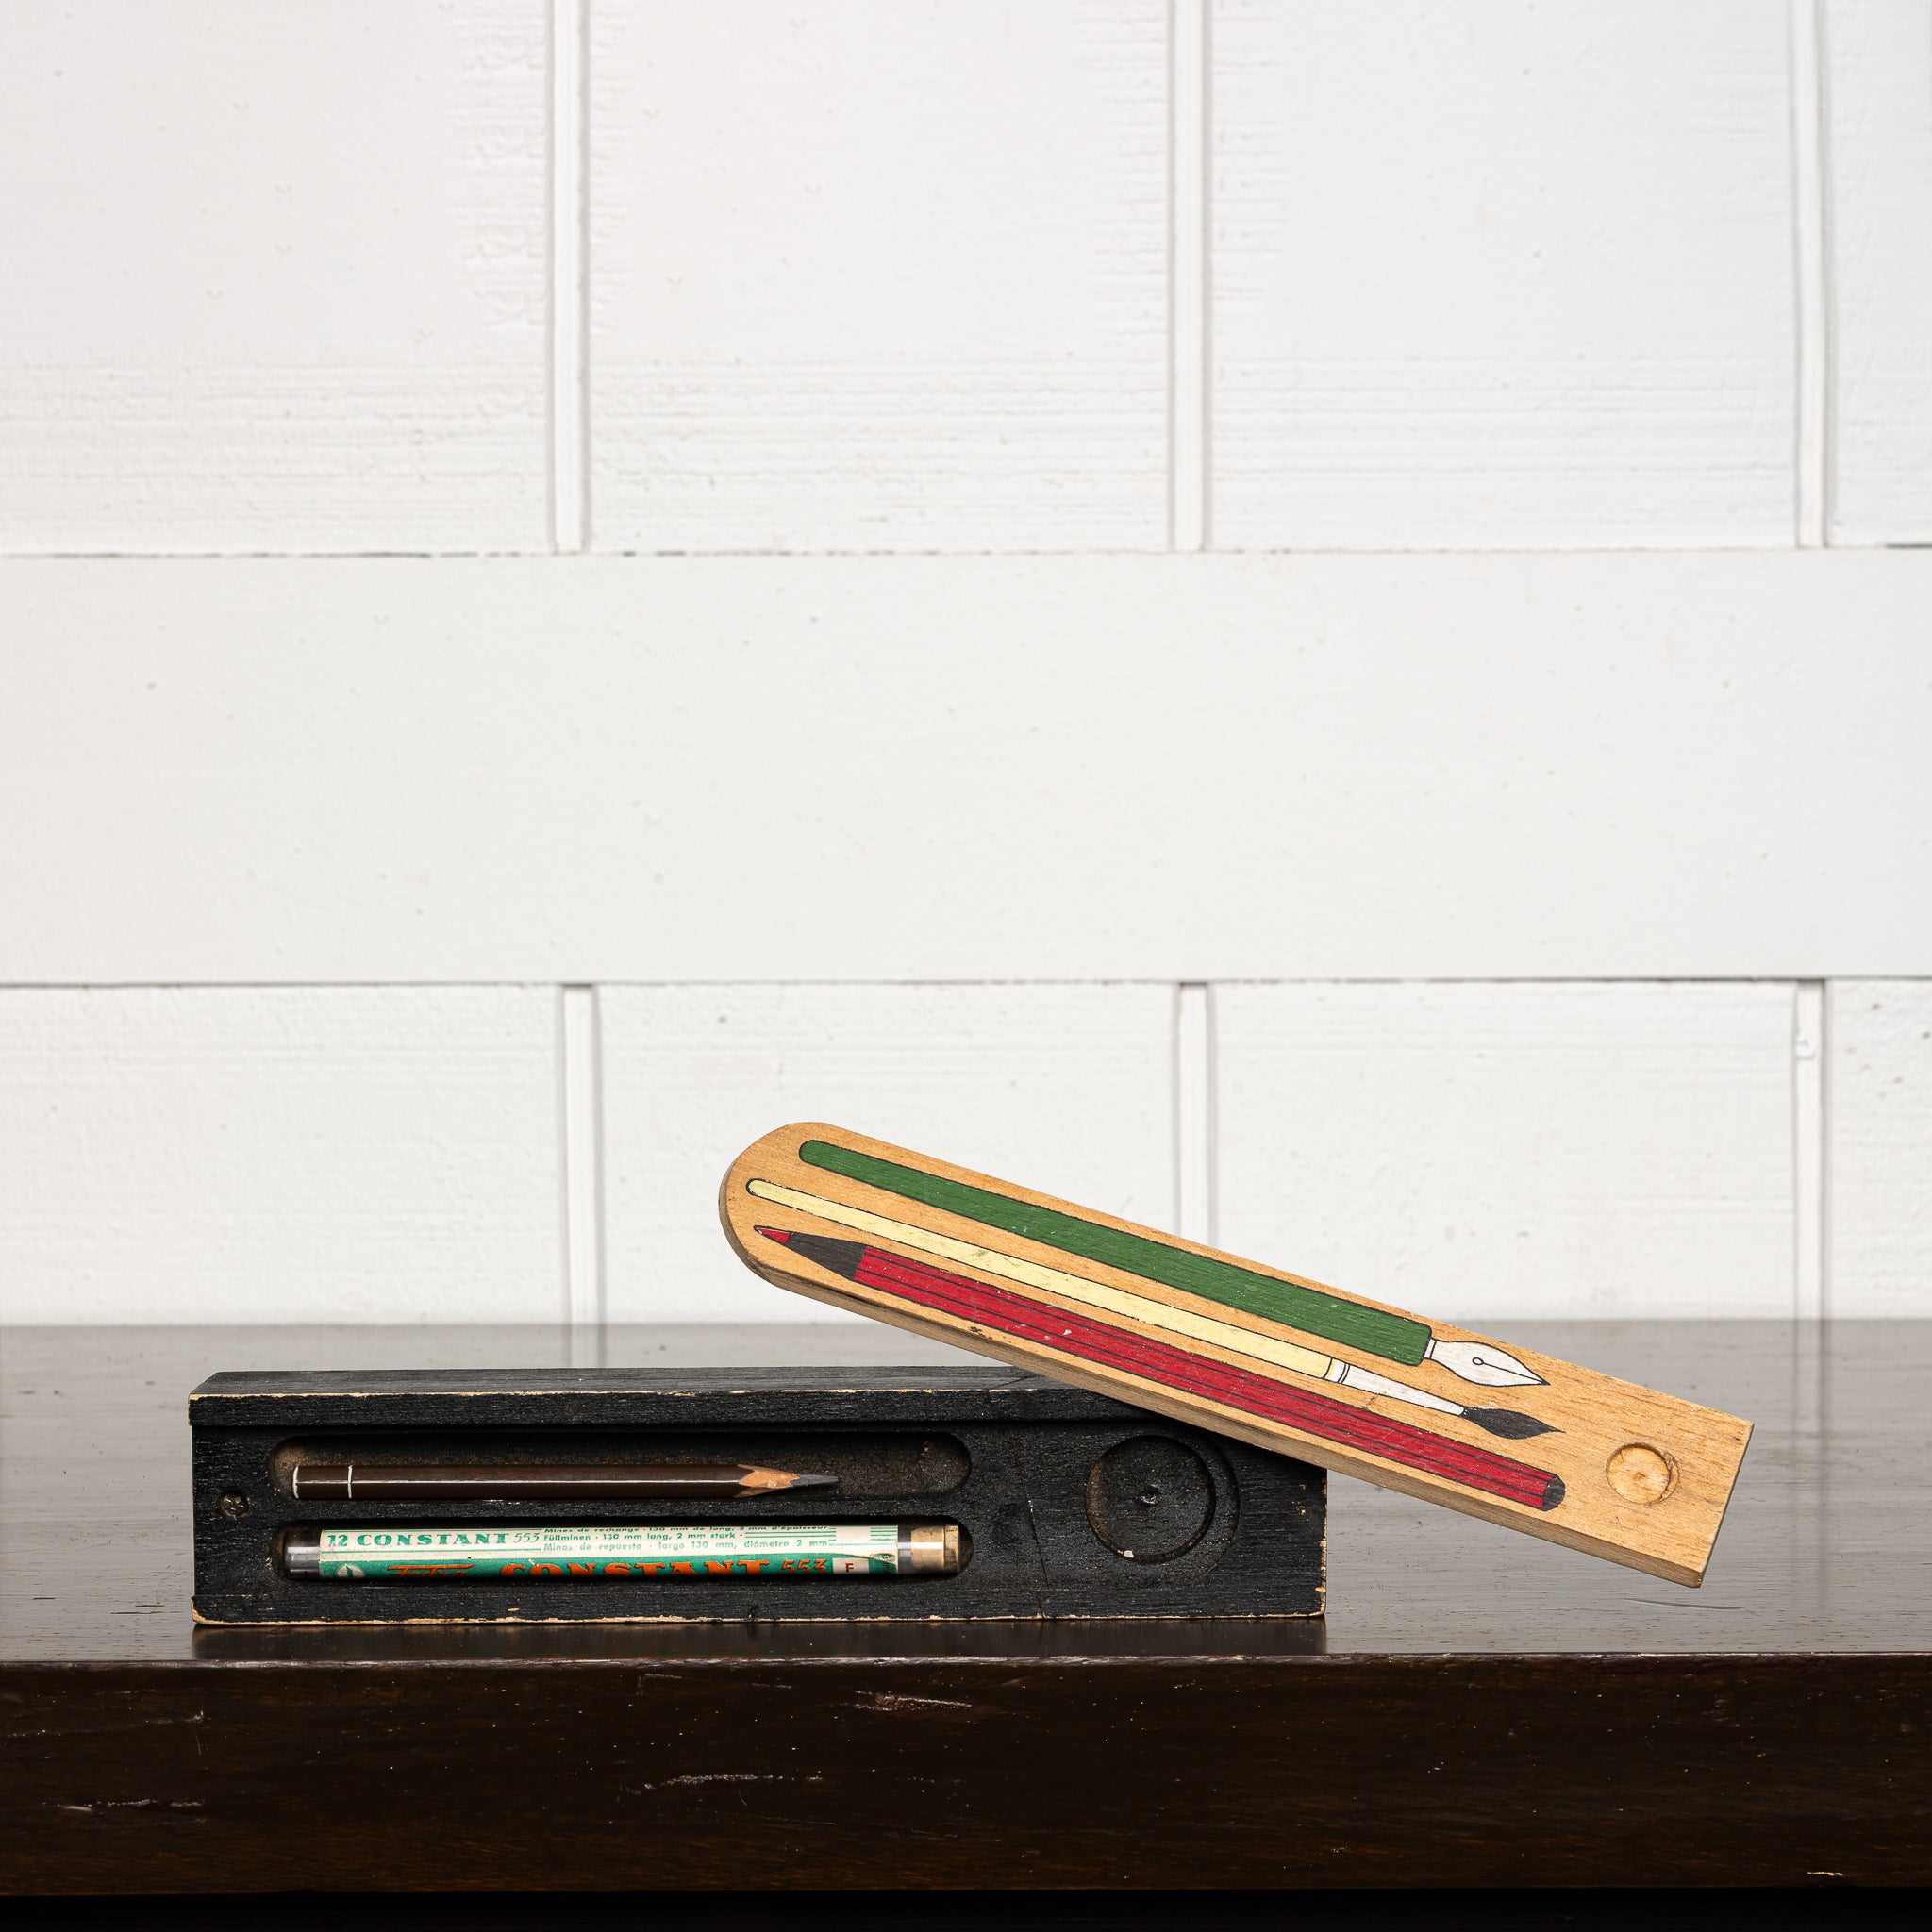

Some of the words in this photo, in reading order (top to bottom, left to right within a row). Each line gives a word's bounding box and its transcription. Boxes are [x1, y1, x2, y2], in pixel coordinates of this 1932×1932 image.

[327, 1534, 348, 1547] 12
[357, 1533, 509, 1546] CONSTANT
[512, 1532, 540, 1543] 553
[599, 1543, 642, 1552] repuesto
[658, 1541, 685, 1551] largo
[796, 1539, 802, 1547] 2
[500, 1559, 769, 1577] CONSTANT
[782, 1559, 827, 1574] 553
